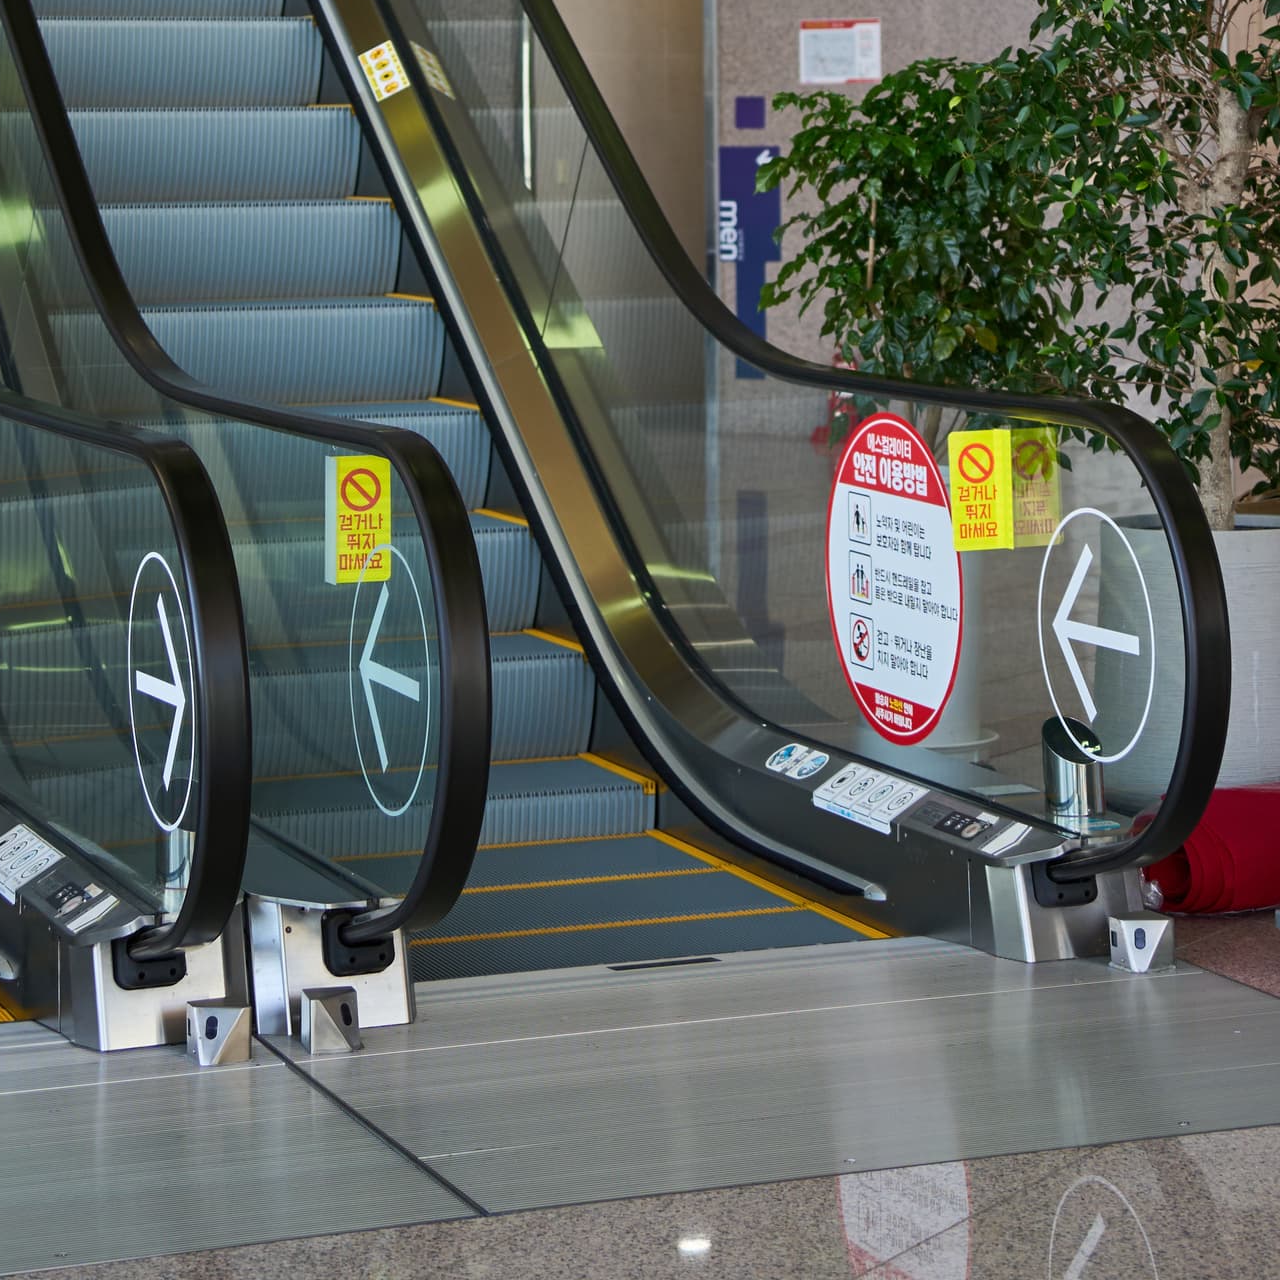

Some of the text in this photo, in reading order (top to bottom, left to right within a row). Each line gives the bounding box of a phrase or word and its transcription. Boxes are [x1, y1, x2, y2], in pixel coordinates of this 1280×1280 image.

[720, 200, 738, 261] men
[866, 432, 912, 460] 에스컬레이터
[852, 451, 928, 497] 안전 이용방법
[958, 484, 998, 502] 걷거나
[965, 503, 991, 520] 뛰지
[338, 513, 384, 531] 걷거나
[959, 521, 998, 539] 마세요
[346, 533, 376, 550] 뛰지
[338, 553, 384, 570] 마세요
